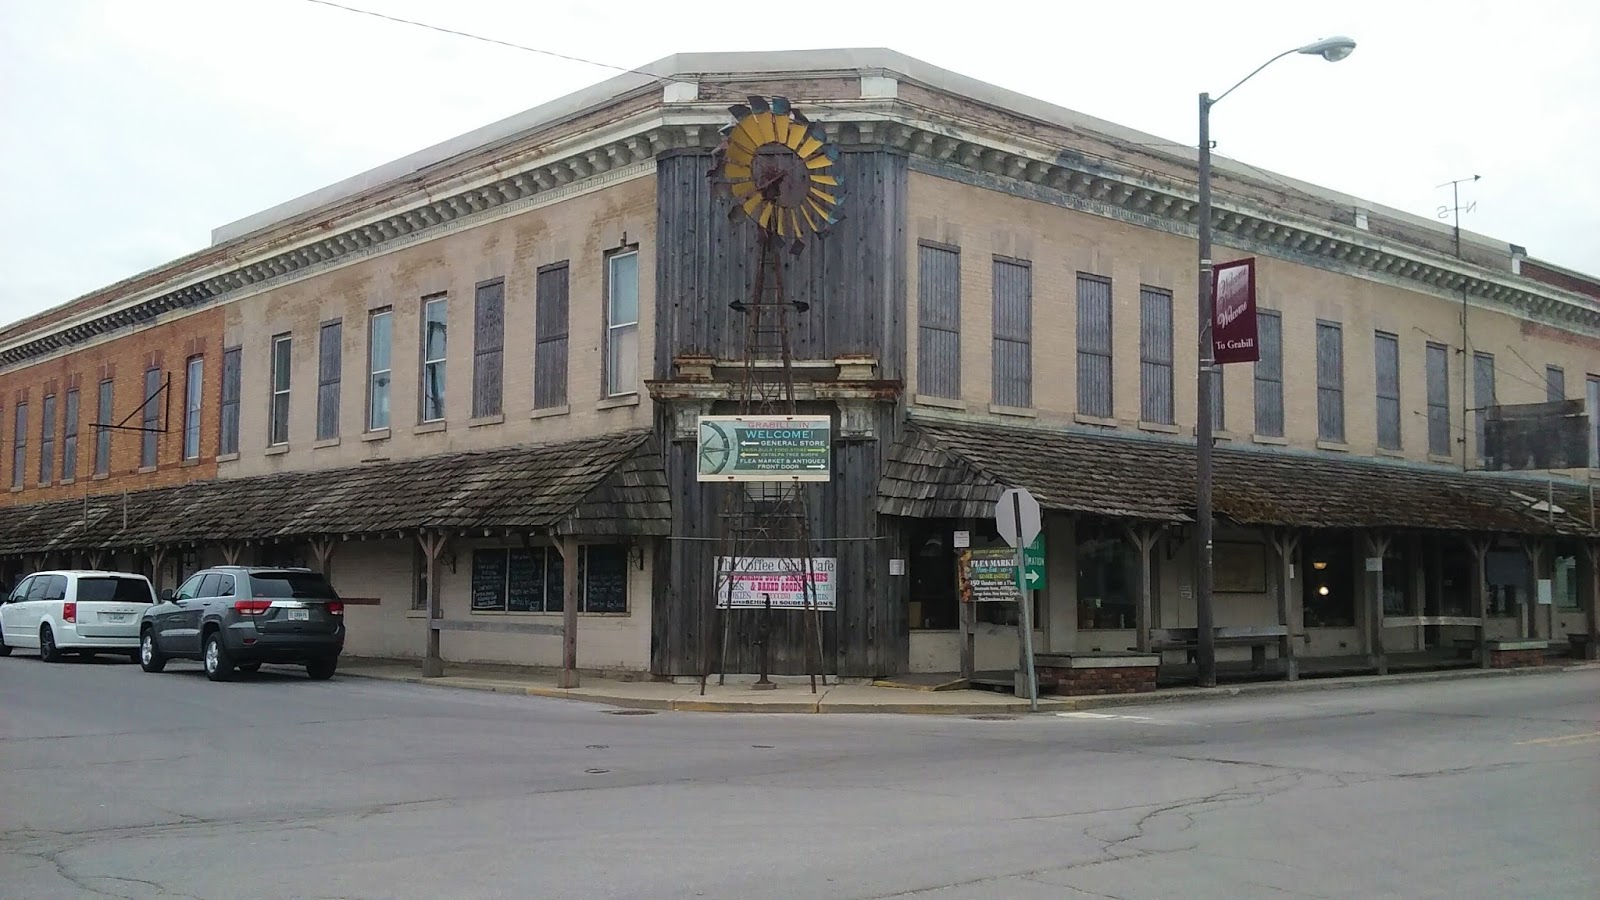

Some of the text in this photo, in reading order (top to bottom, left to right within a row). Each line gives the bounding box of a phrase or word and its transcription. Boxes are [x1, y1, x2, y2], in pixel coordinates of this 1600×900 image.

[1217, 301, 1248, 329] Welcome
[1215, 338, 1254, 350] To Grabill
[745, 430, 814, 439] WELCOME!
[740, 558, 774, 571] Coffee
[777, 558, 805, 571] Cabi
[970, 560, 989, 568] FLEA
[750, 582, 756, 591] &
[757, 582, 779, 592] BAKED
[780, 582, 804, 592] GOODS
